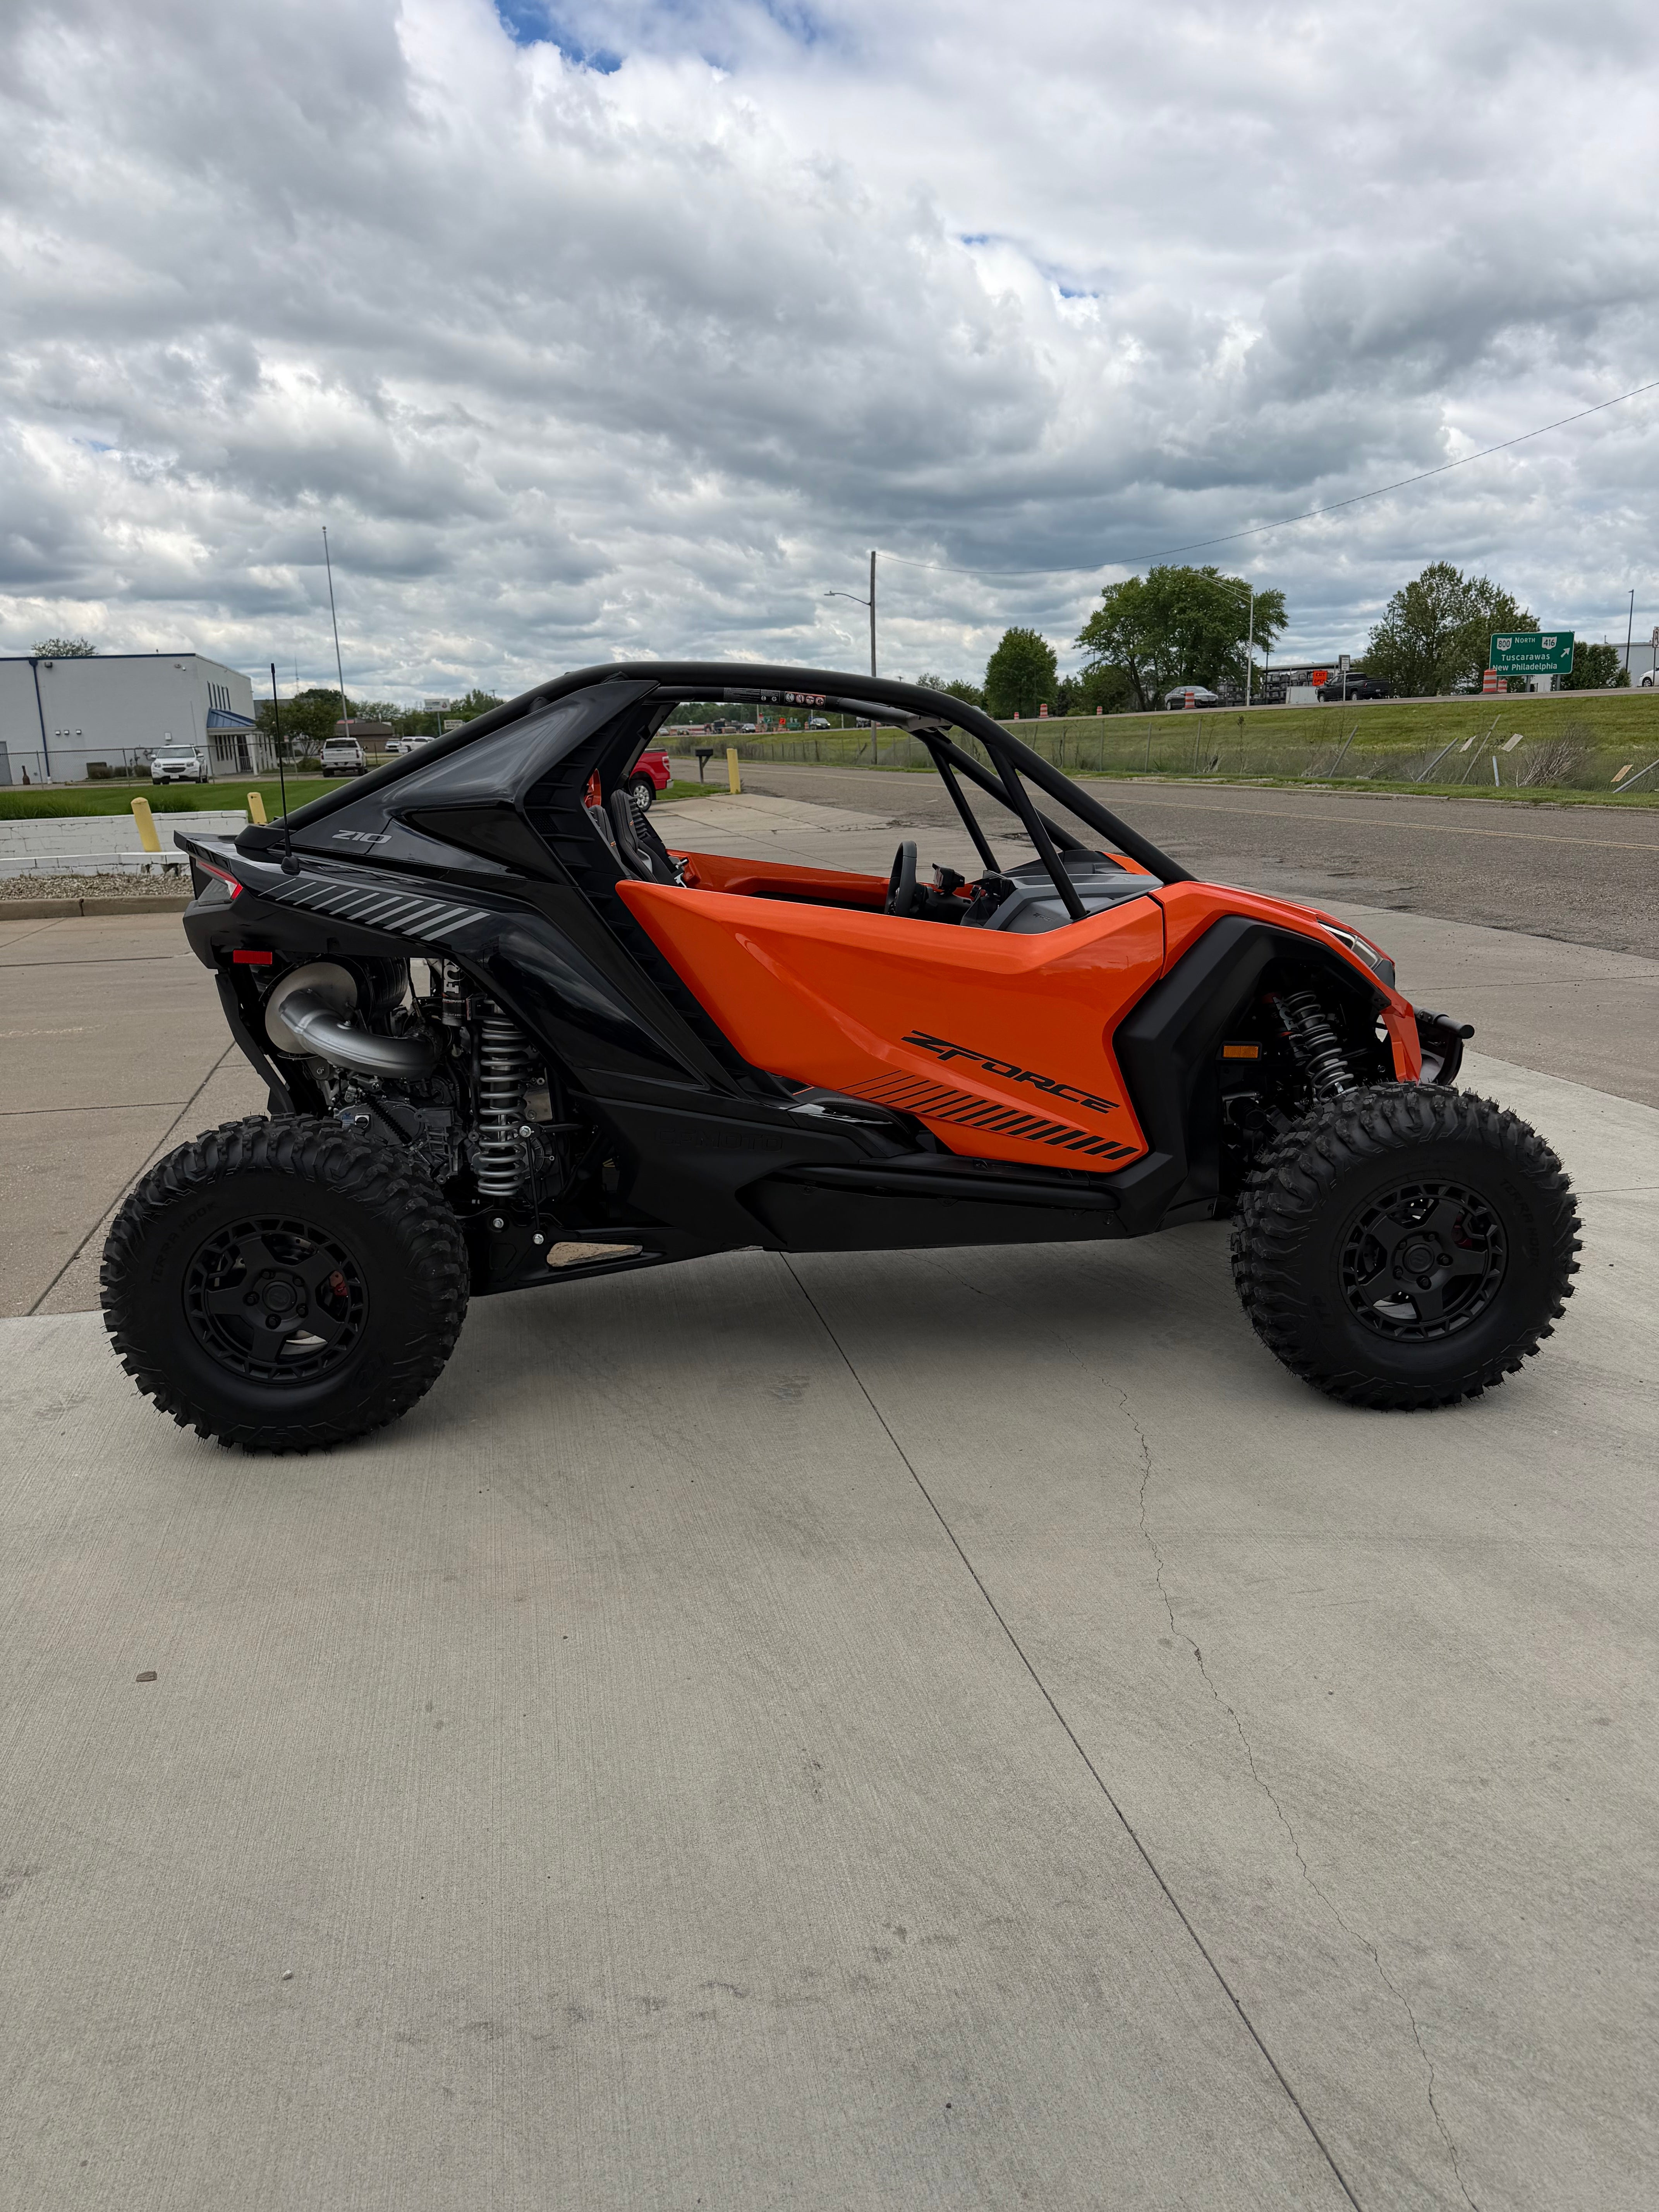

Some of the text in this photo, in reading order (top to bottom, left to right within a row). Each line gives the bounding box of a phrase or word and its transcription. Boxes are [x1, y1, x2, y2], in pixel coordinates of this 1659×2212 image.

[1498, 640, 1510, 648] 800
[1501, 653, 1550, 661] Tuscarawas
[1511, 663, 1558, 672] Philadelphia
[331, 830, 392, 844] Z10
[901, 1030, 1121, 1114] ZFORCE
[654, 1127, 783, 1152] CFMOTO
[1499, 1178, 1540, 1267] TERRA HOOK
[150, 1202, 218, 1285] TERRA HOOK
